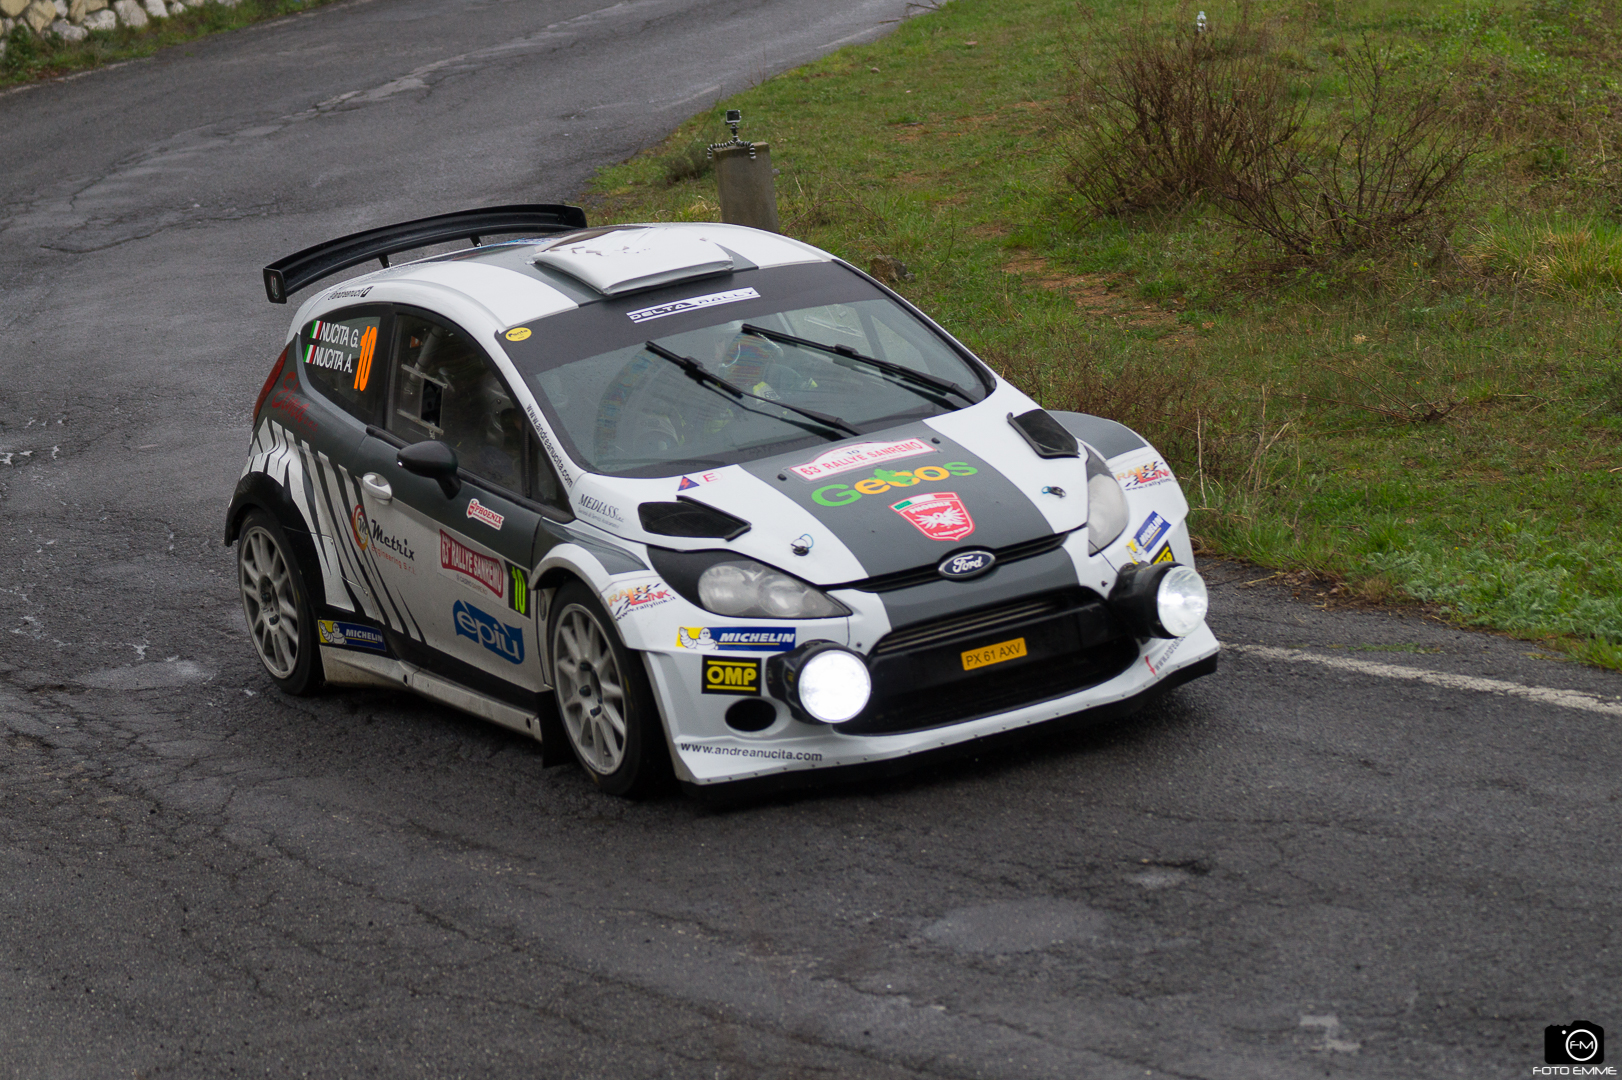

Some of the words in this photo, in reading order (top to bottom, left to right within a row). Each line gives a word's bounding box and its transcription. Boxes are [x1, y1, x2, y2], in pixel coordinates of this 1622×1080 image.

[629, 302, 692, 320] DELTA
[698, 290, 754, 304] RALLY
[319, 322, 350, 347] NUCITA
[350, 328, 359, 349] G.
[312, 346, 344, 371] NUCITA
[343, 353, 353, 373] A.
[353, 326, 378, 392] 10
[526, 403, 574, 488] www.andreanucita.com
[822, 453, 868, 470] RALLYE
[866, 441, 923, 458] SANREMO
[702, 472, 719, 483] E
[474, 504, 504, 525] PHOENIX
[578, 493, 620, 519] MEDIASS
[908, 501, 953, 514] PHOENIX
[371, 518, 415, 562] Metrix
[1138, 514, 1164, 546] MICHELIN
[451, 540, 473, 574] RALLYE
[952, 554, 984, 573] Ford
[511, 565, 526, 615] 10
[345, 628, 383, 643] MICHELIN
[719, 632, 796, 643] MICHELIN
[965, 653, 982, 667] PX
[983, 649, 996, 662] 61
[999, 642, 1021, 658] AXV
[706, 665, 757, 686] OMP
[680, 742, 823, 762] www.andreanucita.com
